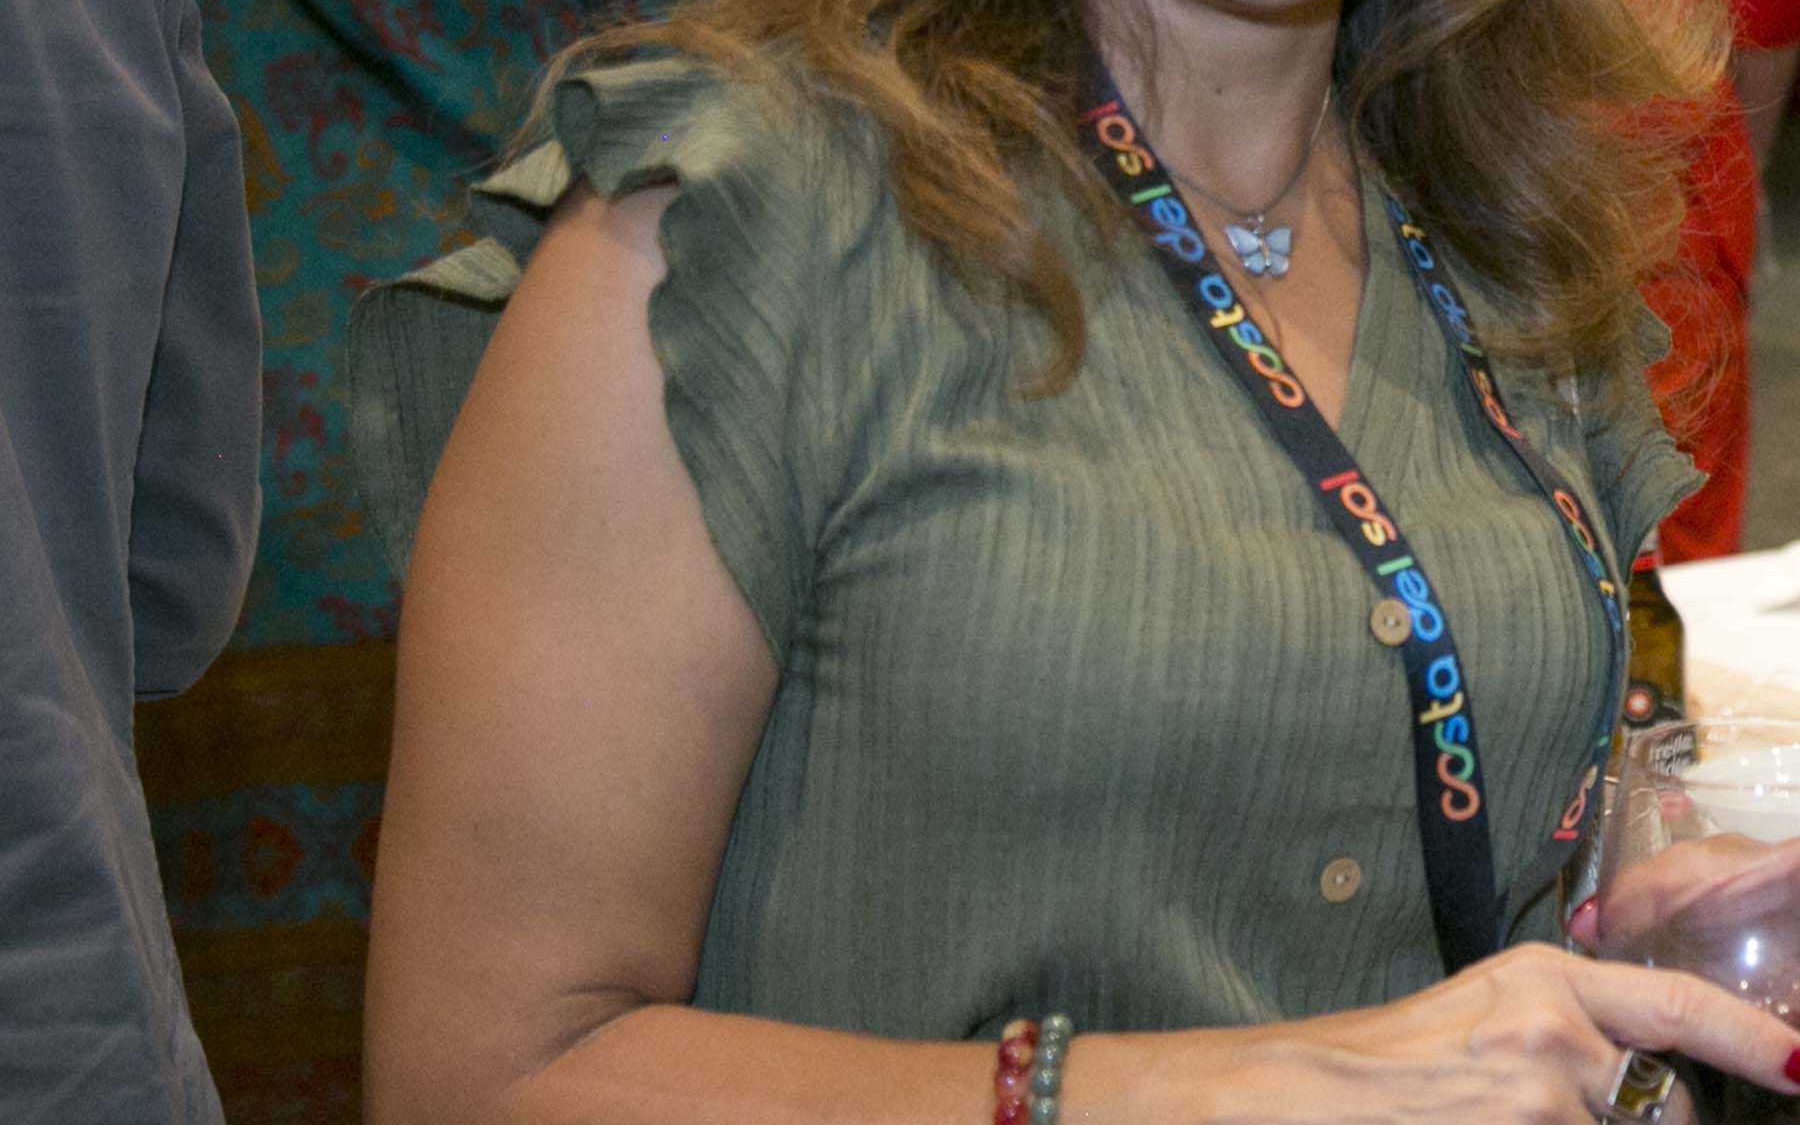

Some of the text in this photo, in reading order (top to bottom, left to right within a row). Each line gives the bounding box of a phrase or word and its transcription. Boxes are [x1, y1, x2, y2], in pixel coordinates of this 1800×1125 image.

[1079, 100, 1305, 409] costa del sol
[1319, 469, 1481, 822] costa del sol
